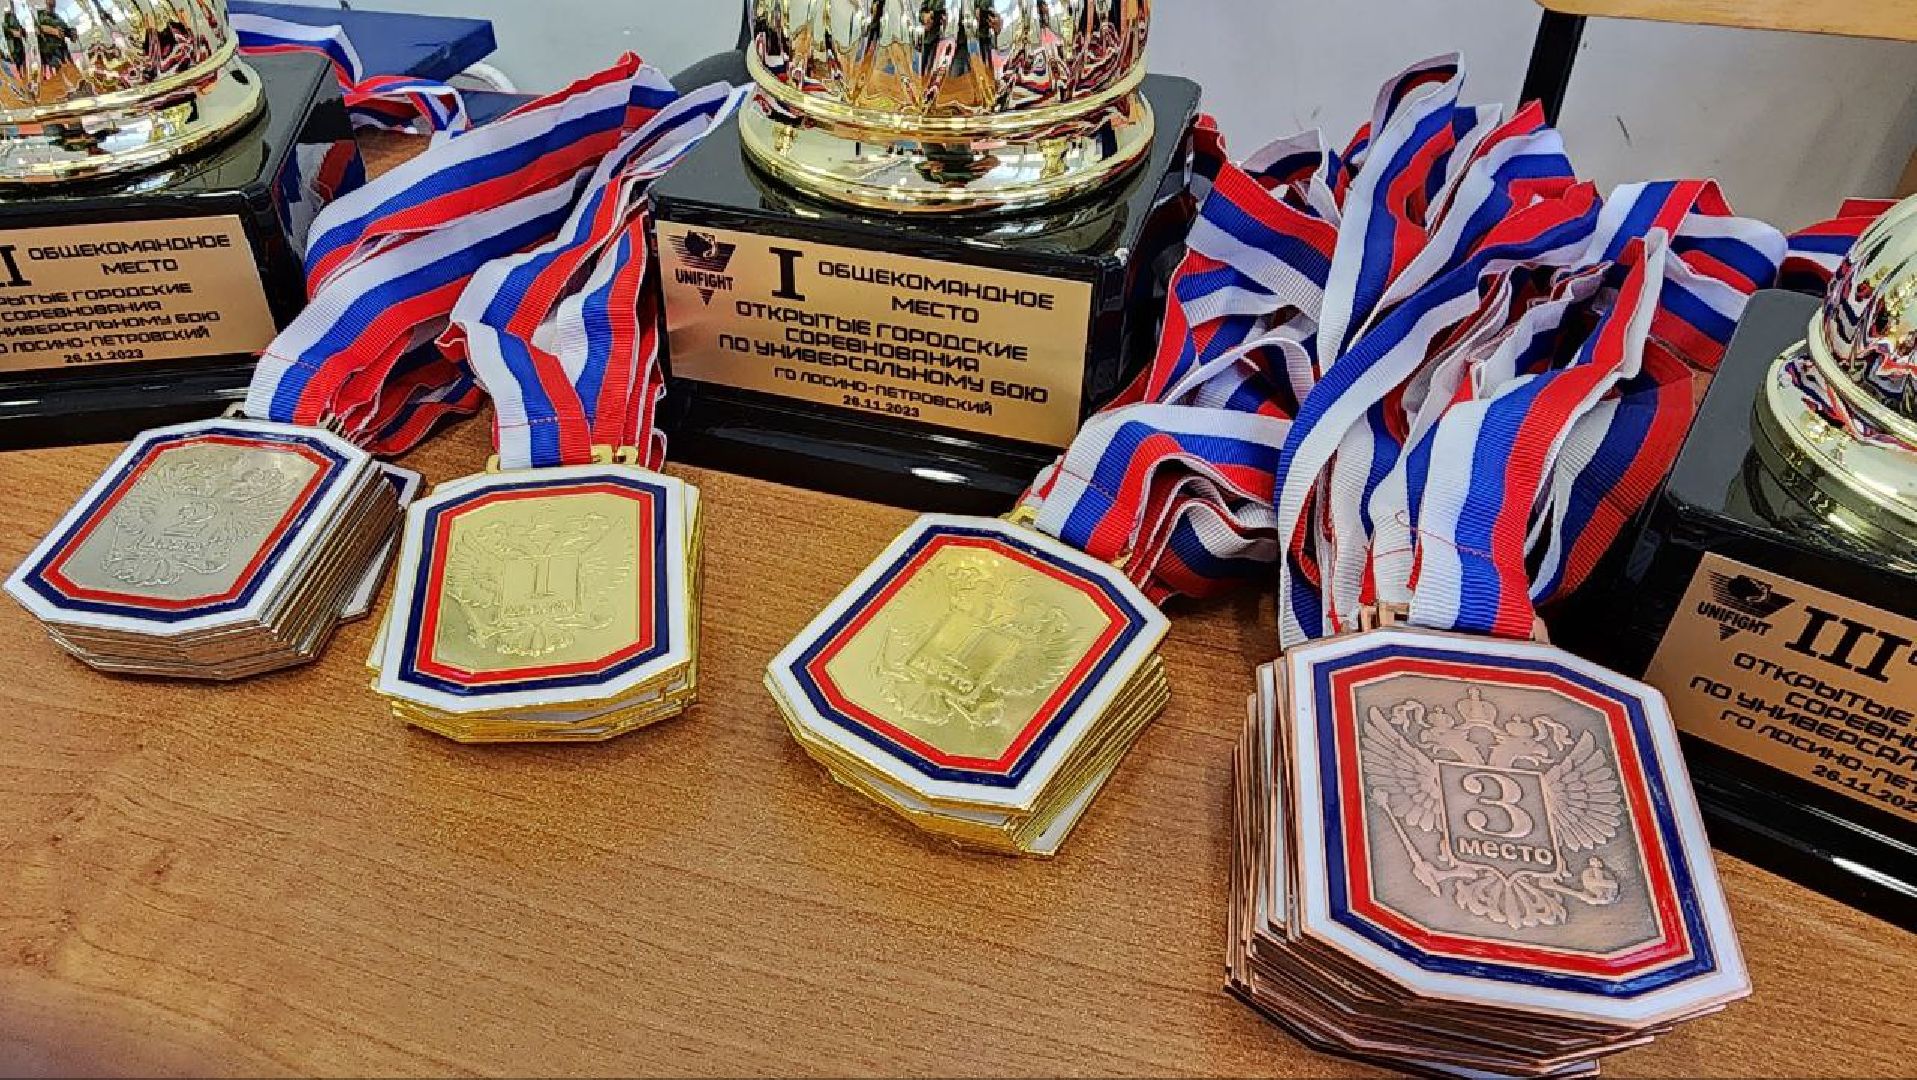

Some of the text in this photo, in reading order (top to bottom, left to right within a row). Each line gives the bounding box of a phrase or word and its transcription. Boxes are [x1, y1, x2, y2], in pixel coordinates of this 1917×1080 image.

[28, 234, 231, 260] ОБЩЕКОМАНДНОЕ
[0, 245, 32, 287] I
[101, 259, 179, 275] МЕСТО
[675, 268, 734, 291] UNIFIGHT
[769, 246, 806, 302] I
[71, 282, 193, 302] ГОРОДСКИЕ
[818, 261, 1055, 311] ОБЩЕКОМАНДНОЕ
[1, 300, 162, 322] СОРЕВНОВАНИЯ
[174, 310, 221, 324] БОЮ
[891, 295, 980, 324] МЕСТО
[13, 325, 211, 353] ЛОСИНО-ПЕТРОВСКИЙ
[736, 301, 1029, 361] ОТКРЫТЫЕ ГОРОДСКИЕ
[63, 349, 144, 364] 26.11.2023
[785, 327, 980, 373] СОРЕВНОВАНИЯ
[719, 333, 1049, 404] ПО УНИВЕРСАЛЬНОМУ БОЮ
[774, 367, 993, 417] ГО ЛОСИНО-ПЕТРОВСКИЙ
[843, 394, 920, 418] 26.11.2023
[1697, 601, 1774, 636] UNIFIGHT
[1784, 605, 1913, 684] III
[1689, 676, 1732, 700] ПО
[1733, 652, 1915, 728] ОТКРЫТЫЕ
[1720, 709, 1756, 730] ГО
[1462, 772, 1534, 838] 3
